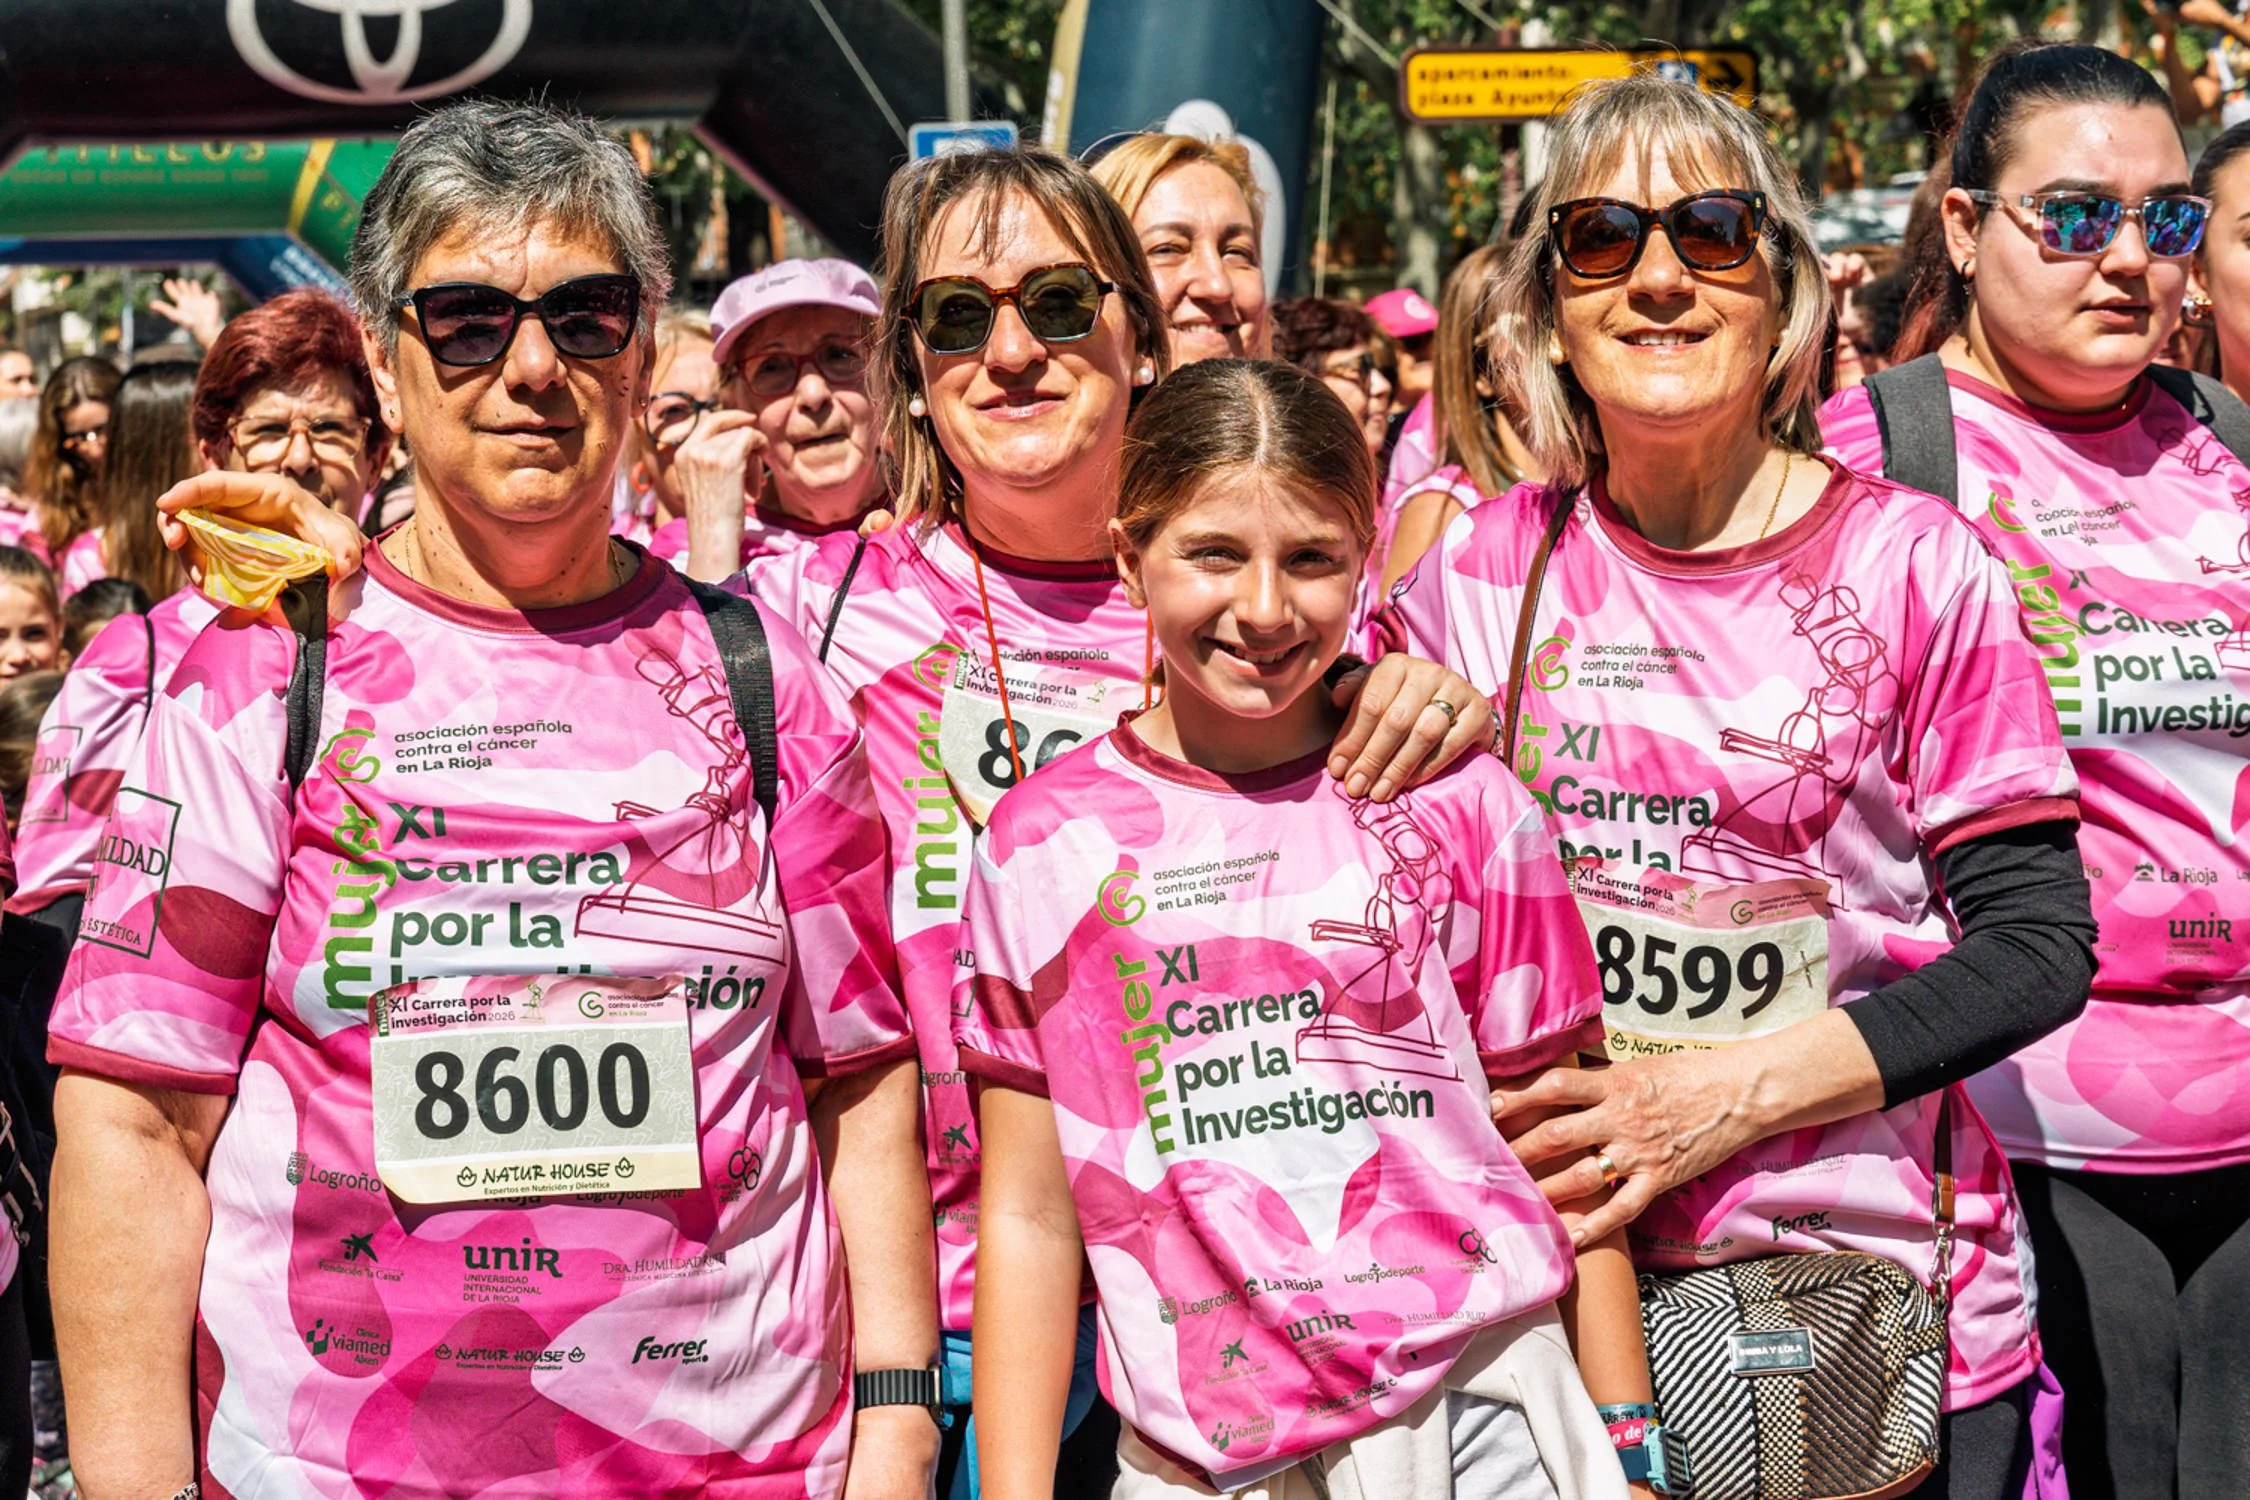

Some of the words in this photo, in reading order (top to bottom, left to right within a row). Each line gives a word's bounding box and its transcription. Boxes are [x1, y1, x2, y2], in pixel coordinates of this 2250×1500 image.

[1045, 648, 1110, 663] española
[1584, 643, 1648, 657] asociación
[1651, 645, 1706, 663] española
[1580, 659, 1620, 671] contra
[1622, 660, 1635, 672] el
[1636, 660, 1678, 674] cáncer
[2094, 653, 2165, 693] por
[2172, 646, 2217, 682] la
[966, 679, 1052, 705] invesigación
[989, 671, 1040, 690] Crrera
[1039, 682, 1063, 695] por
[1064, 684, 1078, 697] la
[1577, 677, 1594, 688] en
[1596, 675, 1610, 687] La
[1613, 675, 1645, 691] Rioja
[394, 724, 489, 743] asociación
[493, 720, 573, 737] española
[1554, 722, 1602, 763] XI
[395, 742, 452, 759] contra
[457, 740, 472, 752] el
[477, 738, 538, 751] cáncer
[396, 763, 418, 774] en
[423, 760, 444, 772] La
[449, 756, 493, 771] Rioja
[1550, 775, 1713, 829] Carrera
[386, 802, 448, 844] XI
[1153, 861, 1220, 881] asociación
[1223, 850, 1280, 869] española
[2160, 867, 2180, 883] La
[2183, 867, 2218, 886] Rioja
[1155, 881, 1197, 895] contra
[1199, 877, 1211, 888] el
[1213, 871, 1256, 886] cáncer
[1577, 866, 1594, 882] XI
[1597, 874, 1641, 893] Carrera
[1643, 885, 1663, 897] por
[1664, 889, 1675, 902] la
[1157, 901, 1173, 911] en
[1175, 897, 1192, 908] La
[1194, 890, 1227, 905] Rioja
[1577, 883, 1656, 910] investigación
[1655, 904, 1677, 916] 2026
[390, 911, 494, 959] por
[509, 902, 564, 949] la
[1155, 945, 1200, 987] XI
[1597, 925, 1785, 1021] 8599
[390, 996, 408, 1013] XI
[411, 998, 467, 1011] Carrera
[470, 996, 495, 1009] por
[497, 994, 512, 1006] la
[1166, 988, 1322, 1037] Carrera
[391, 1010, 487, 1029] investigación
[488, 1010, 516, 1023] 2026
[1113, 952, 1175, 1155] mujer
[1175, 1053, 1246, 1103] por
[1251, 1040, 1291, 1080] la
[415, 1042, 651, 1140] 8600
[1183, 1080, 1435, 1146] Investigación
[310, 1164, 383, 1193] Logroño
[482, 1164, 546, 1185] NATUR
[550, 1163, 611, 1180] HOUSE
[484, 1186, 520, 1196] Expertos
[532, 1183, 568, 1193] Nutrición
[569, 1184, 575, 1193] y
[575, 1181, 611, 1191] Dietética
[1771, 1210, 1830, 1242] Ferrer
[464, 1274, 529, 1285] UNIVERSIDAD
[464, 1284, 542, 1295] INTERNACIONAL
[1264, 1278, 1282, 1292] La
[1286, 1278, 1323, 1293] Rioja
[464, 1293, 475, 1302] DE
[478, 1294, 490, 1303] LA
[493, 1294, 521, 1304] RIOJA
[1181, 1290, 1238, 1316] Logroño
[333, 1335, 392, 1357] viamed
[456, 1347, 509, 1361] NATUR
[514, 1350, 566, 1363] HOUSE
[631, 1336, 708, 1365] Ferrer
[1231, 1417, 1275, 1440] viamed
